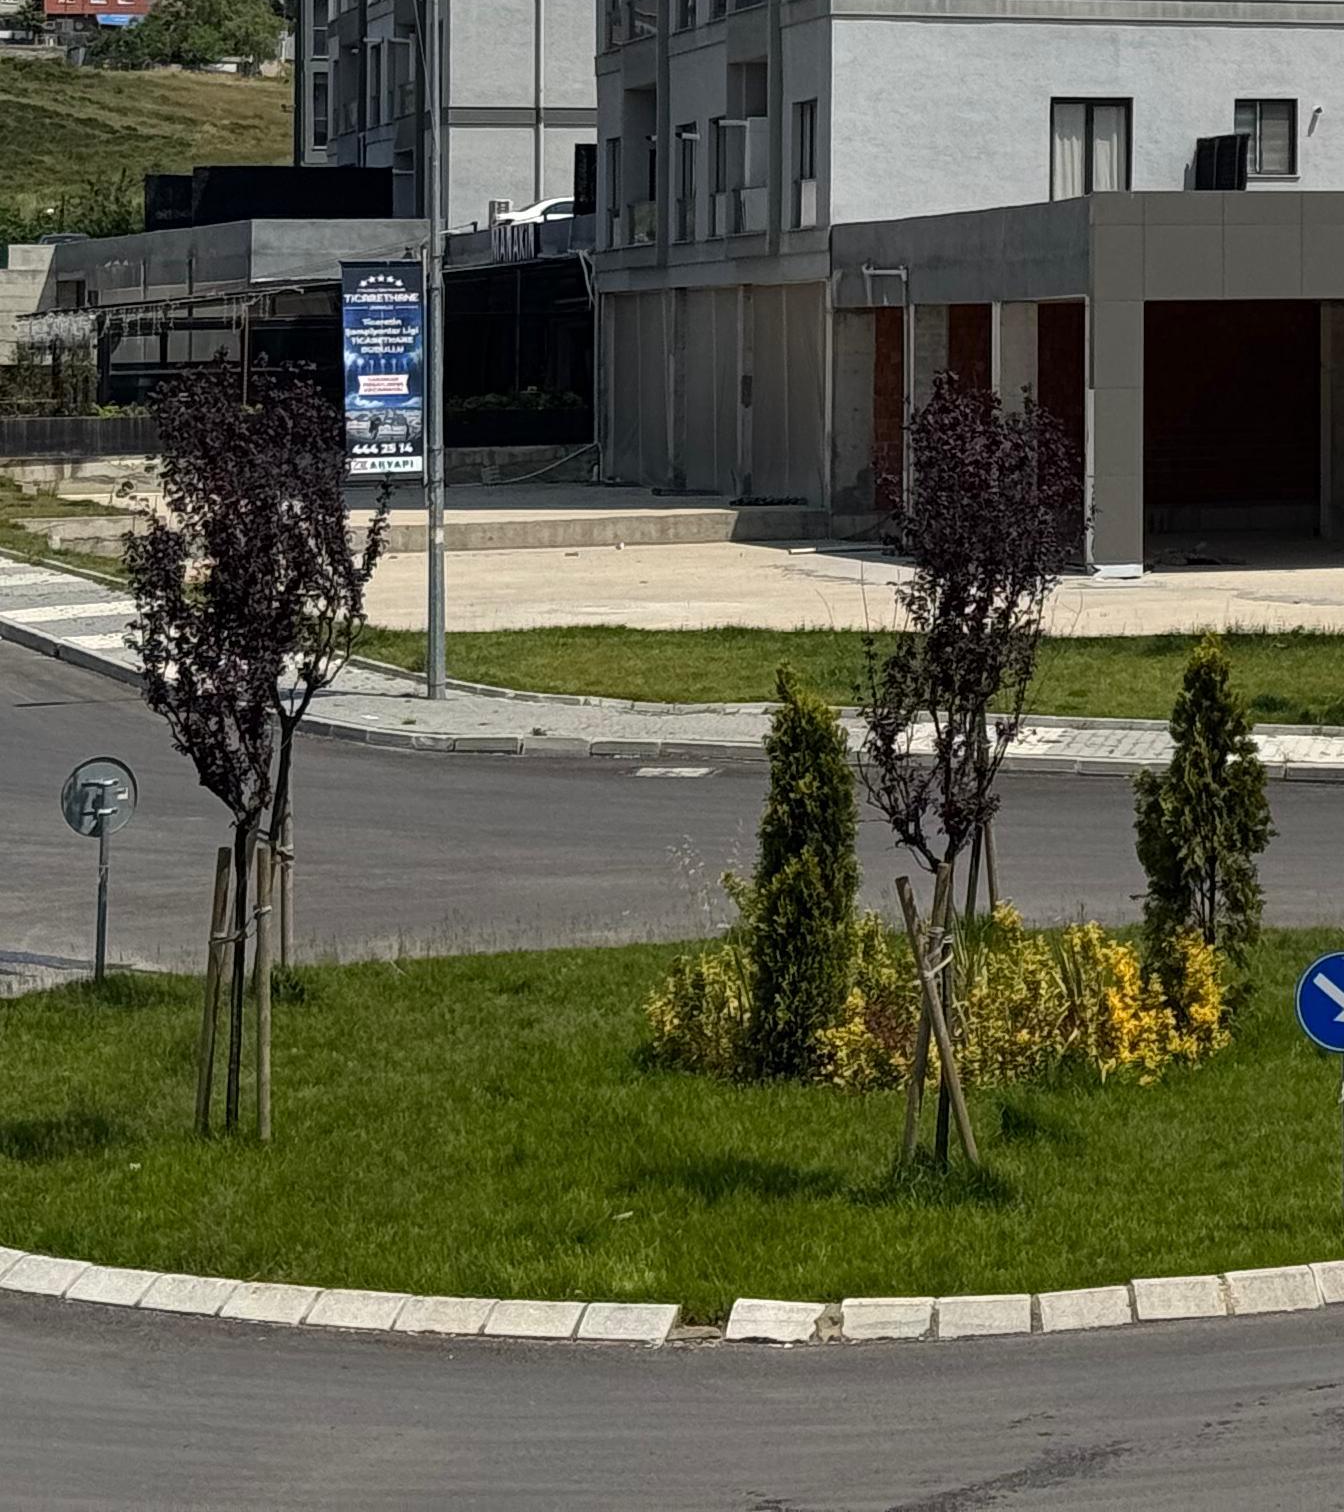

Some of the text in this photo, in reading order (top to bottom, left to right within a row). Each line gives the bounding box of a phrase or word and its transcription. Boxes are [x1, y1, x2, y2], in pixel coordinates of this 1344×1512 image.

[352, 442, 413, 455] 444 25 14
